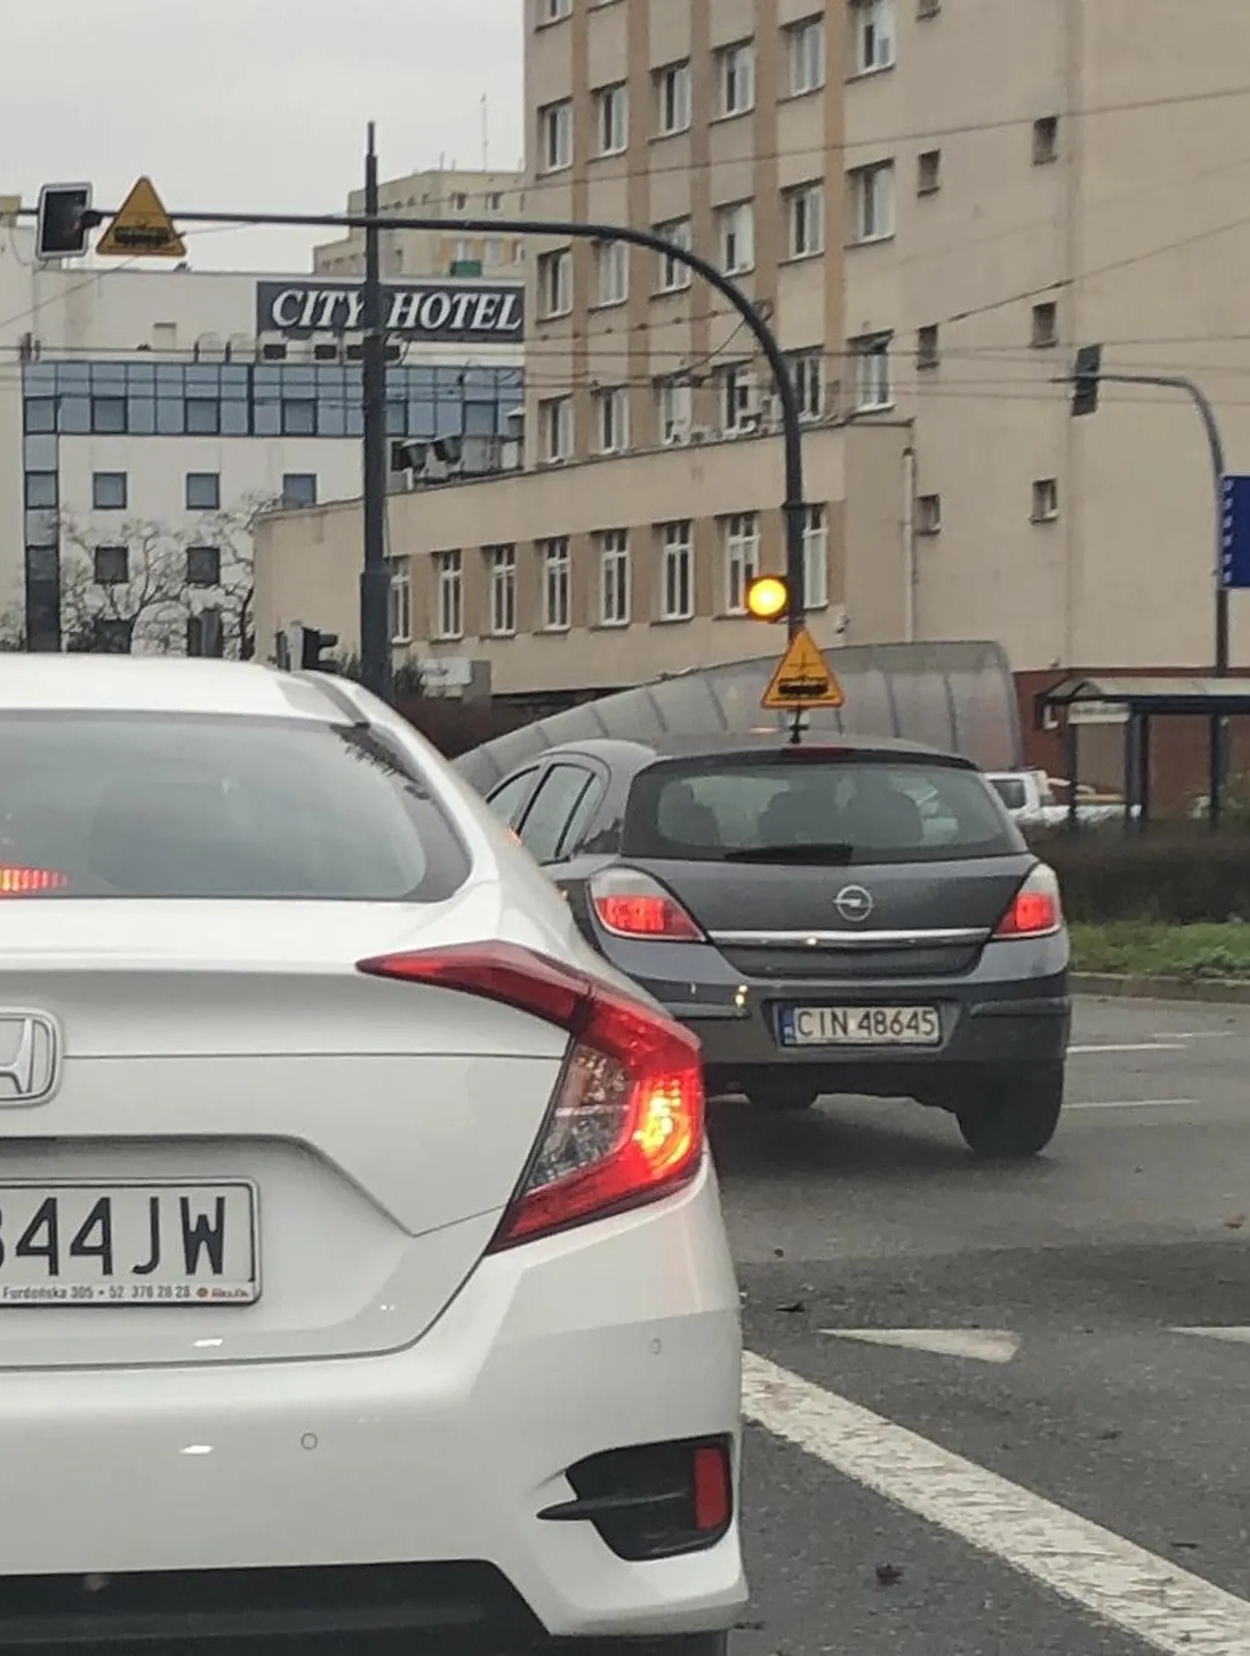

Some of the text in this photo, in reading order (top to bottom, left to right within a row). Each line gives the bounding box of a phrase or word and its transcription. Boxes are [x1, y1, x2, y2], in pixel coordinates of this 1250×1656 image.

[271, 289, 522, 331] CITY HOTEL
[797, 1010, 936, 1037] CIN 48645
[108, 1285, 125, 1299] 52
